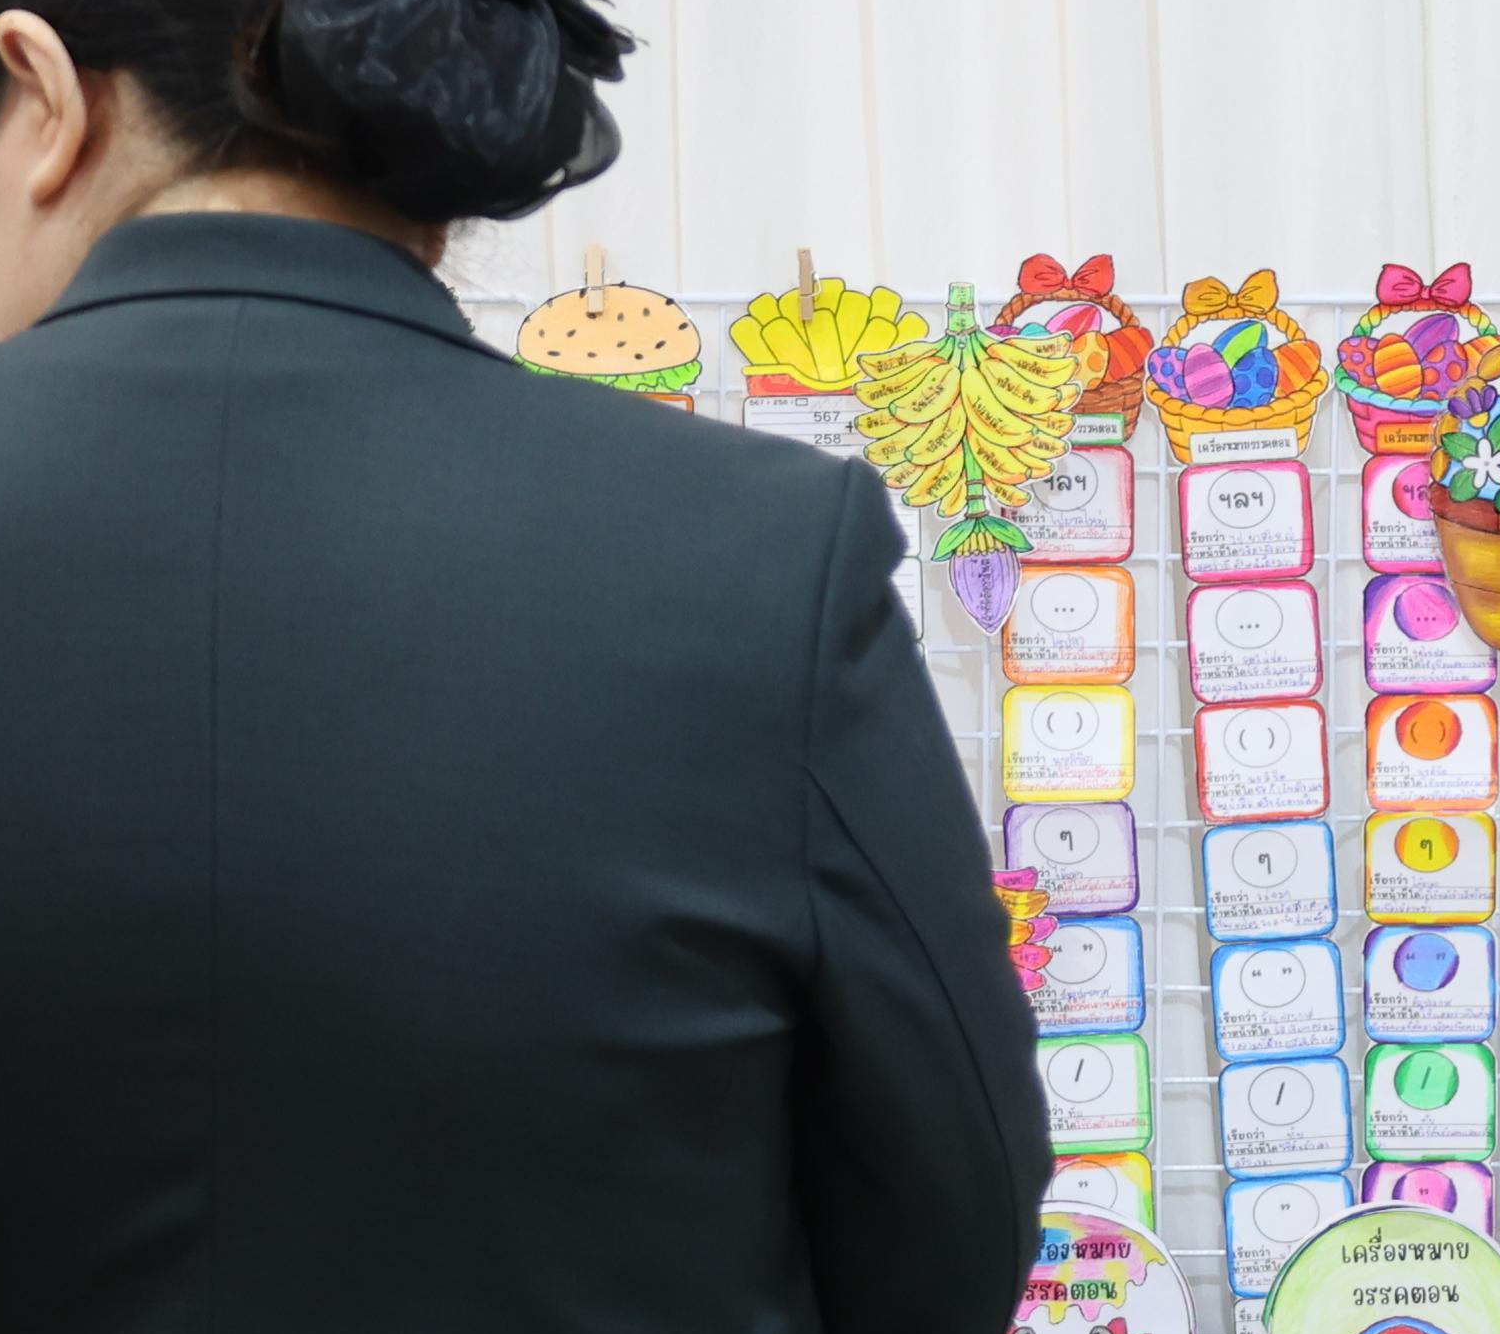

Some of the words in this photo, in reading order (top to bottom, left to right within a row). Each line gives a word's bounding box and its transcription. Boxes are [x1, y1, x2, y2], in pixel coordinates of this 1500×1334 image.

[814, 411, 840, 422] 567
[814, 434, 841, 445] 258
[1342, 1228, 1471, 1266] เครื่องหมาย
[1353, 1281, 1461, 1308] วรรคตอน
